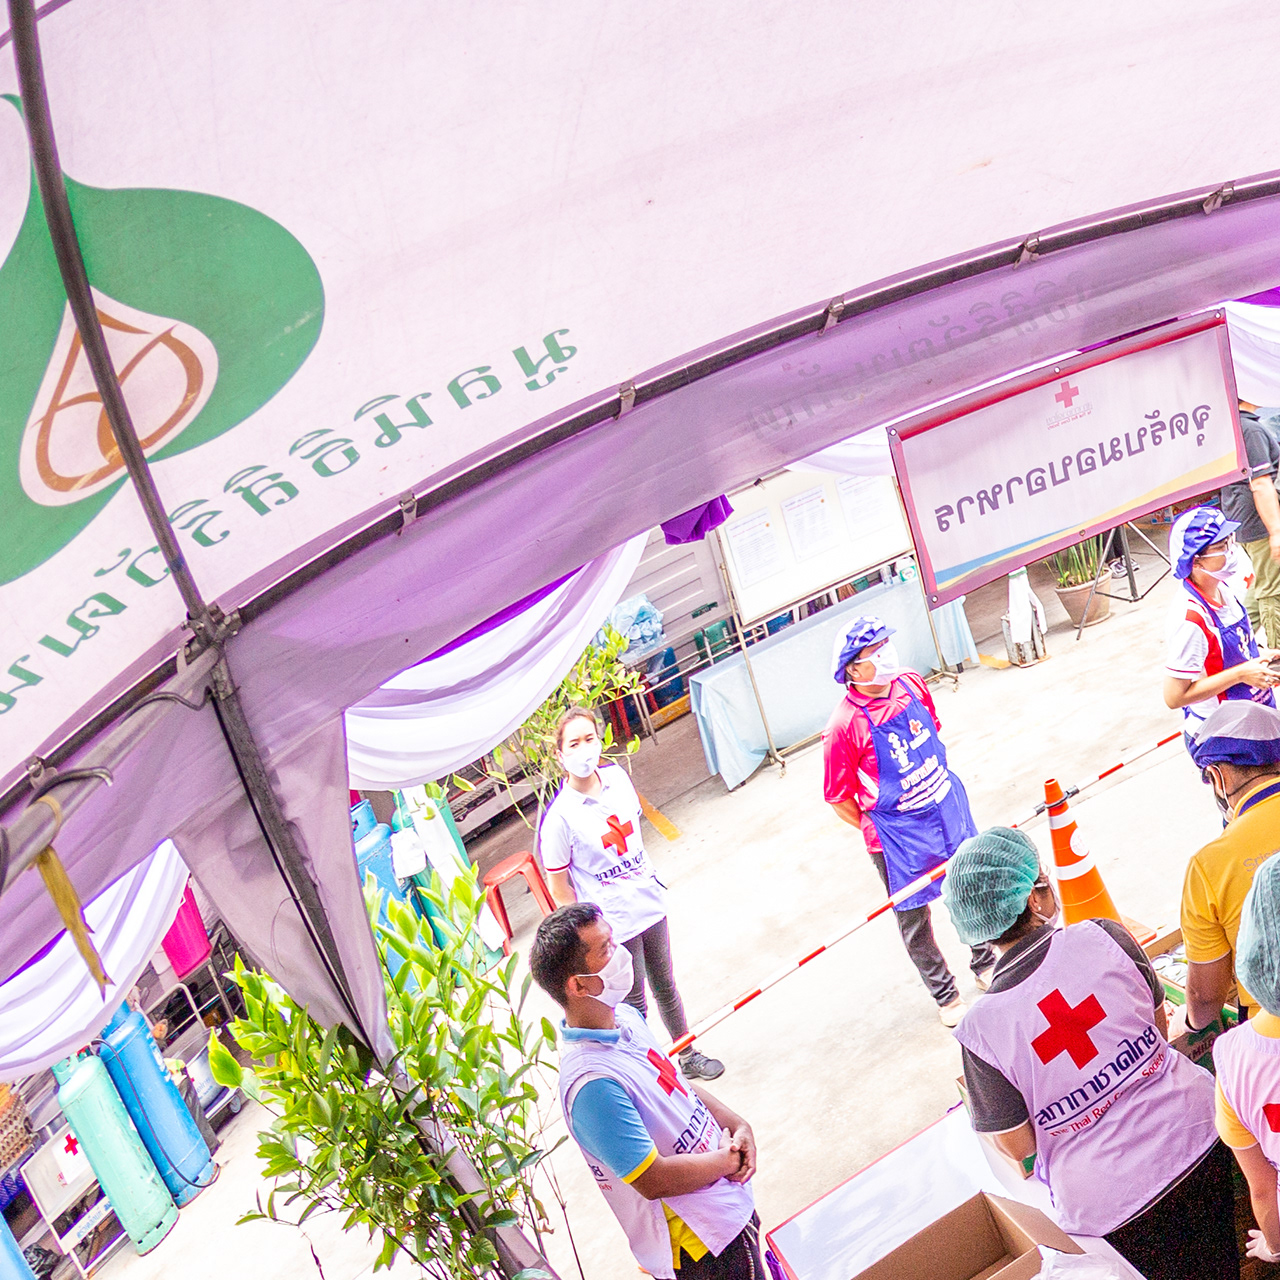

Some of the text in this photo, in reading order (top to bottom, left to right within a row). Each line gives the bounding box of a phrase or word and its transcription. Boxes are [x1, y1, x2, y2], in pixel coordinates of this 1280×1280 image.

[1034, 1025, 1158, 1126] สภากาชาดไทย
[1069, 1114, 1092, 1132] Thai
[1091, 1099, 1112, 1119] Red
